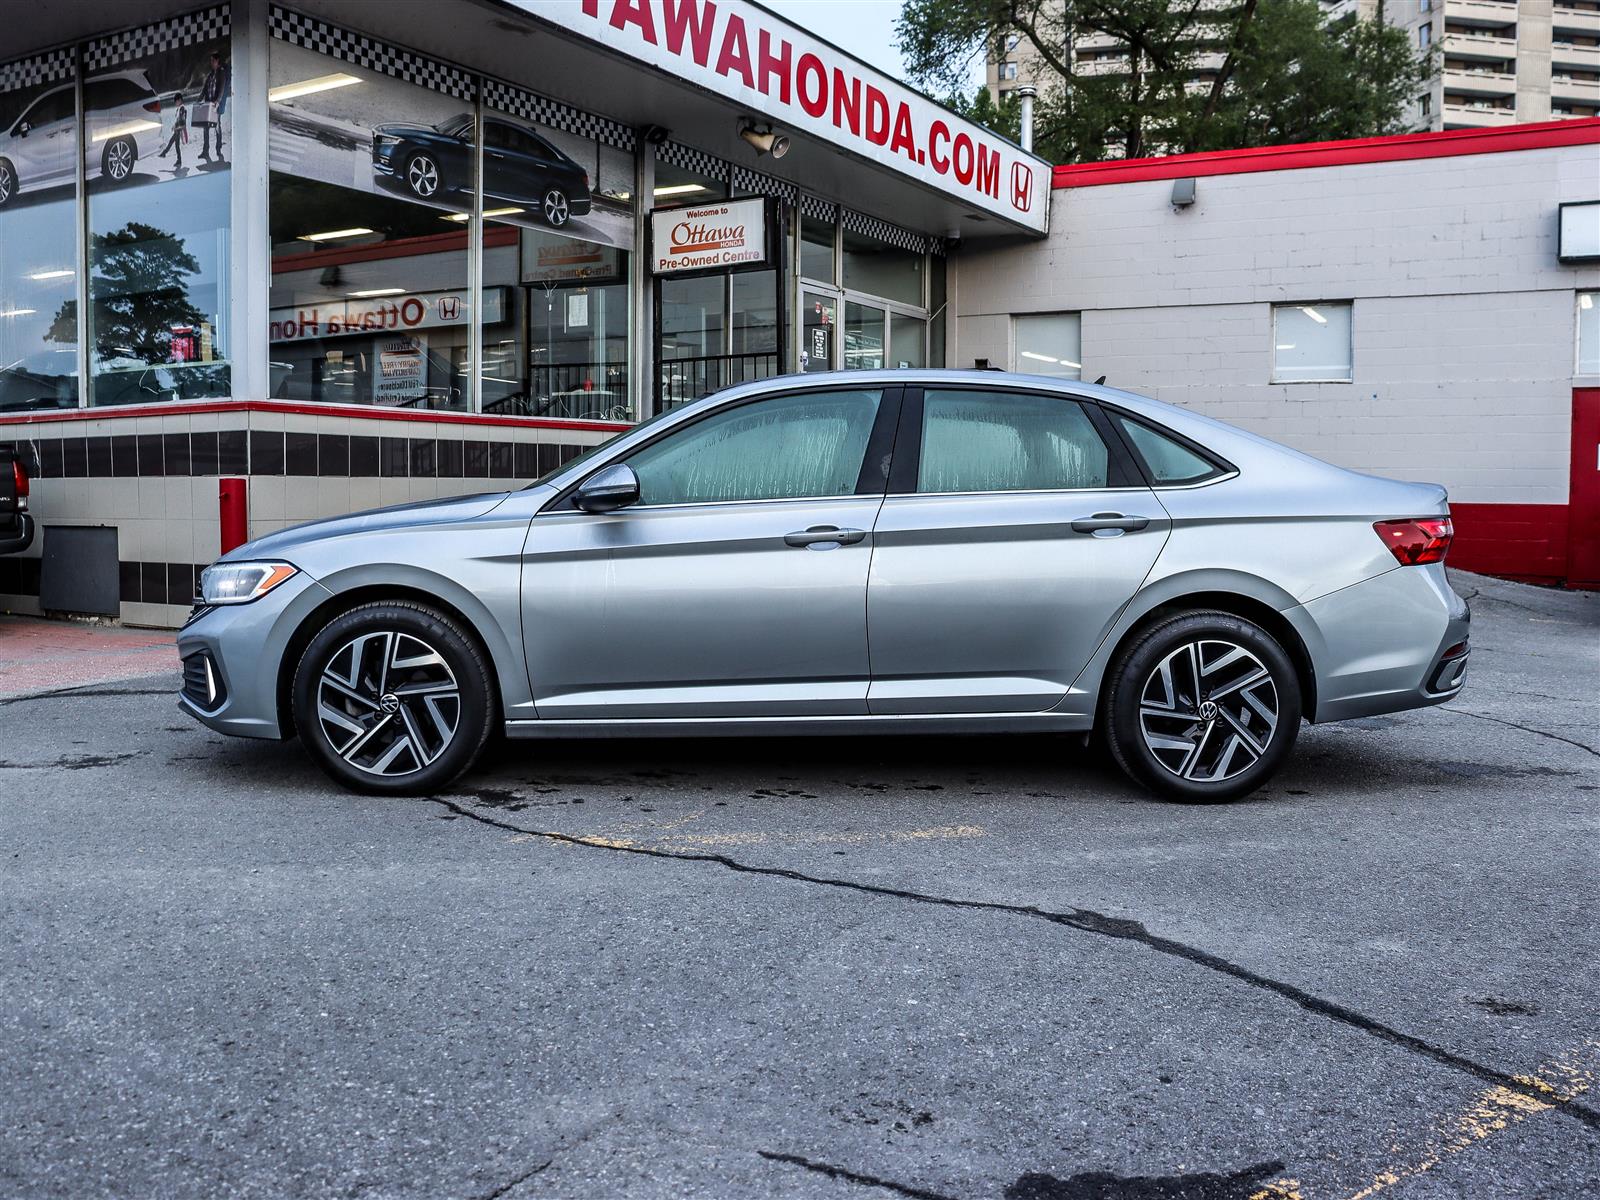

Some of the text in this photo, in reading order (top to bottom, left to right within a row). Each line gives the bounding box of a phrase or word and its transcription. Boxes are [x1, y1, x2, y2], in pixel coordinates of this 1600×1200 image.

[582, 0, 1000, 200] AWAHONDA.COM
[686, 207, 728, 219] Welcome to
[671, 221, 745, 246] Ottawa
[720, 239, 743, 248] HONDA
[659, 250, 760, 270] Pre-Owned Centre
